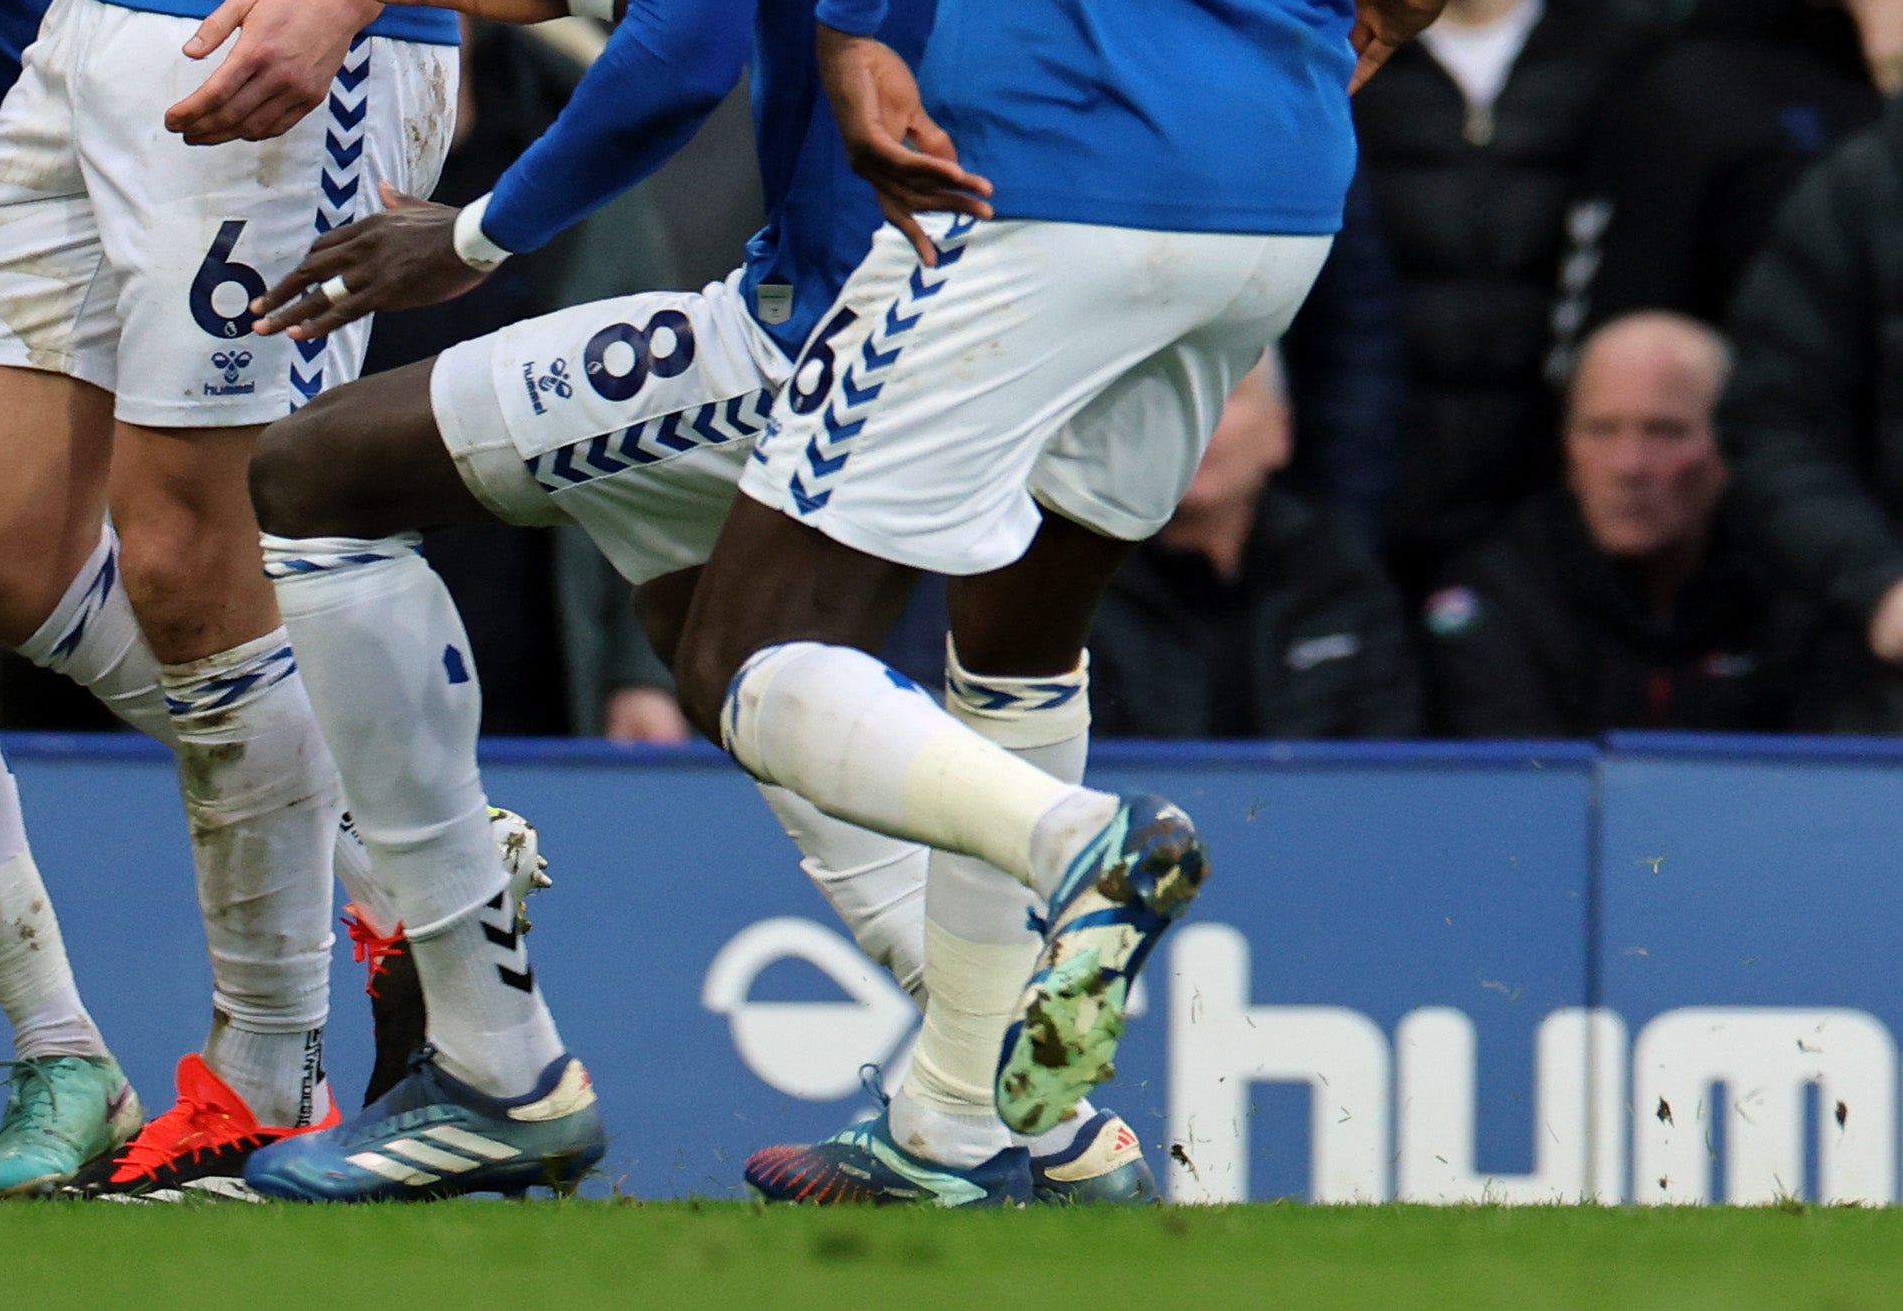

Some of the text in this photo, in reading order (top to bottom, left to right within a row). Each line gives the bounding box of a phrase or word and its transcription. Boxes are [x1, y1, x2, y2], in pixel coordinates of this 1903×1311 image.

[189, 220, 269, 339] 6
[203, 380, 256, 397] hummel
[521, 361, 548, 416] hummel
[584, 309, 696, 402] 8
[1168, 922, 1895, 1205] hum
